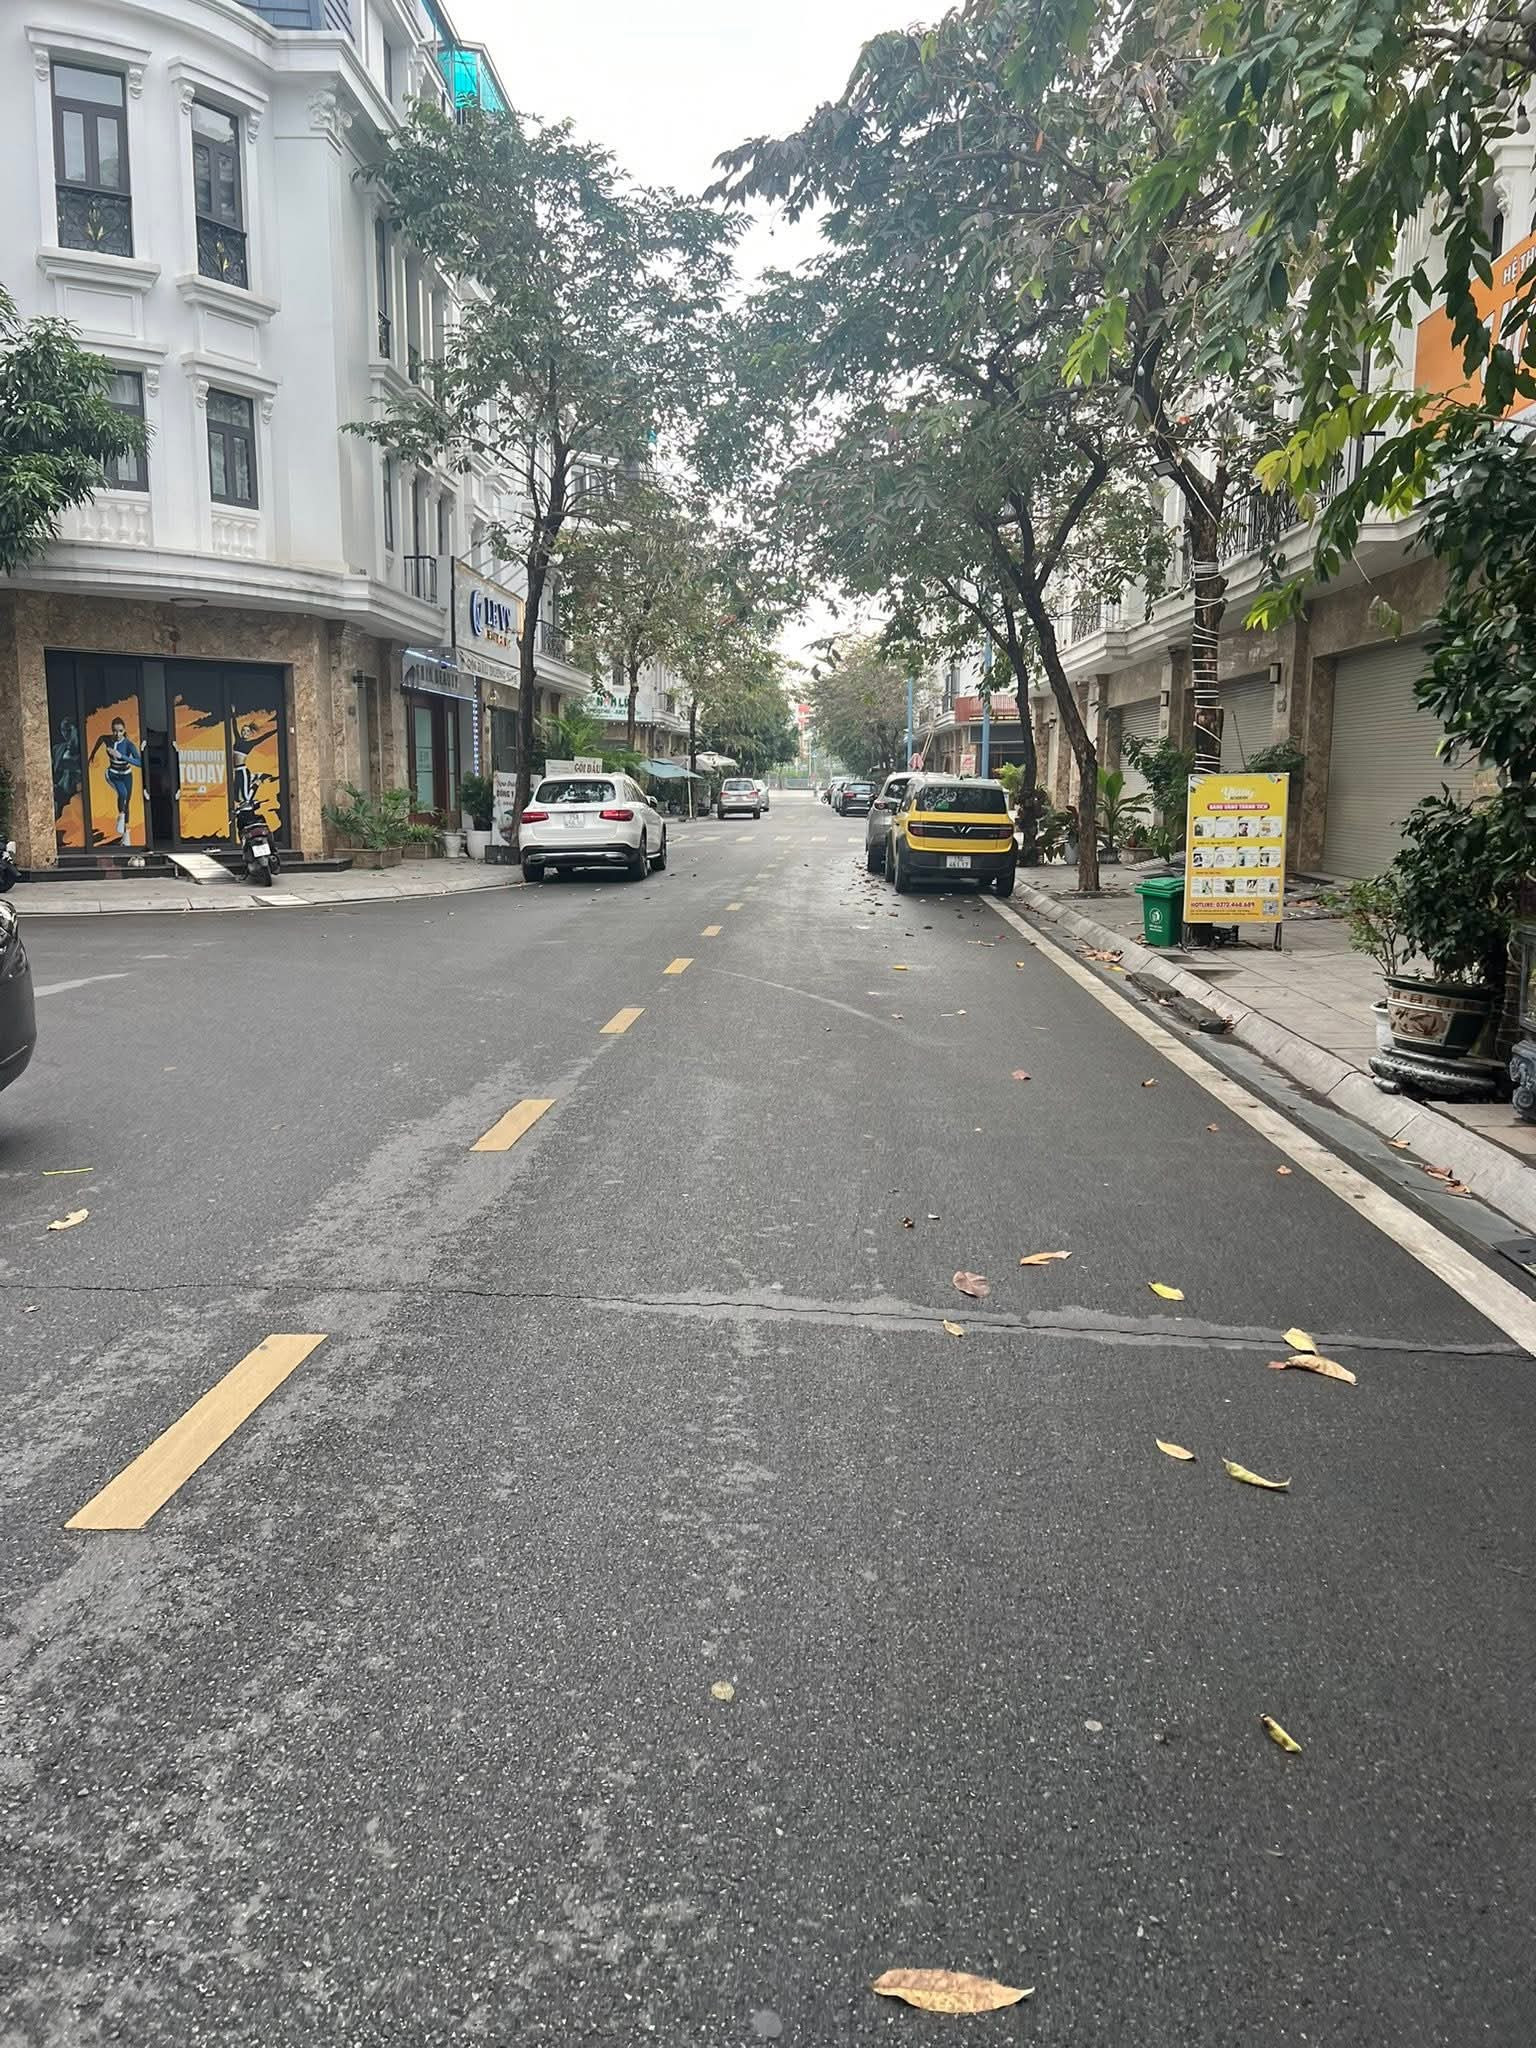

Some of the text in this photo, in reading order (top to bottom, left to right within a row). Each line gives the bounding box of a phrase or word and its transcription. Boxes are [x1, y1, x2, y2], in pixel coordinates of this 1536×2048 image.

[1503, 246, 1536, 286] HỆ TH
[180, 763, 225, 784] TODAY
